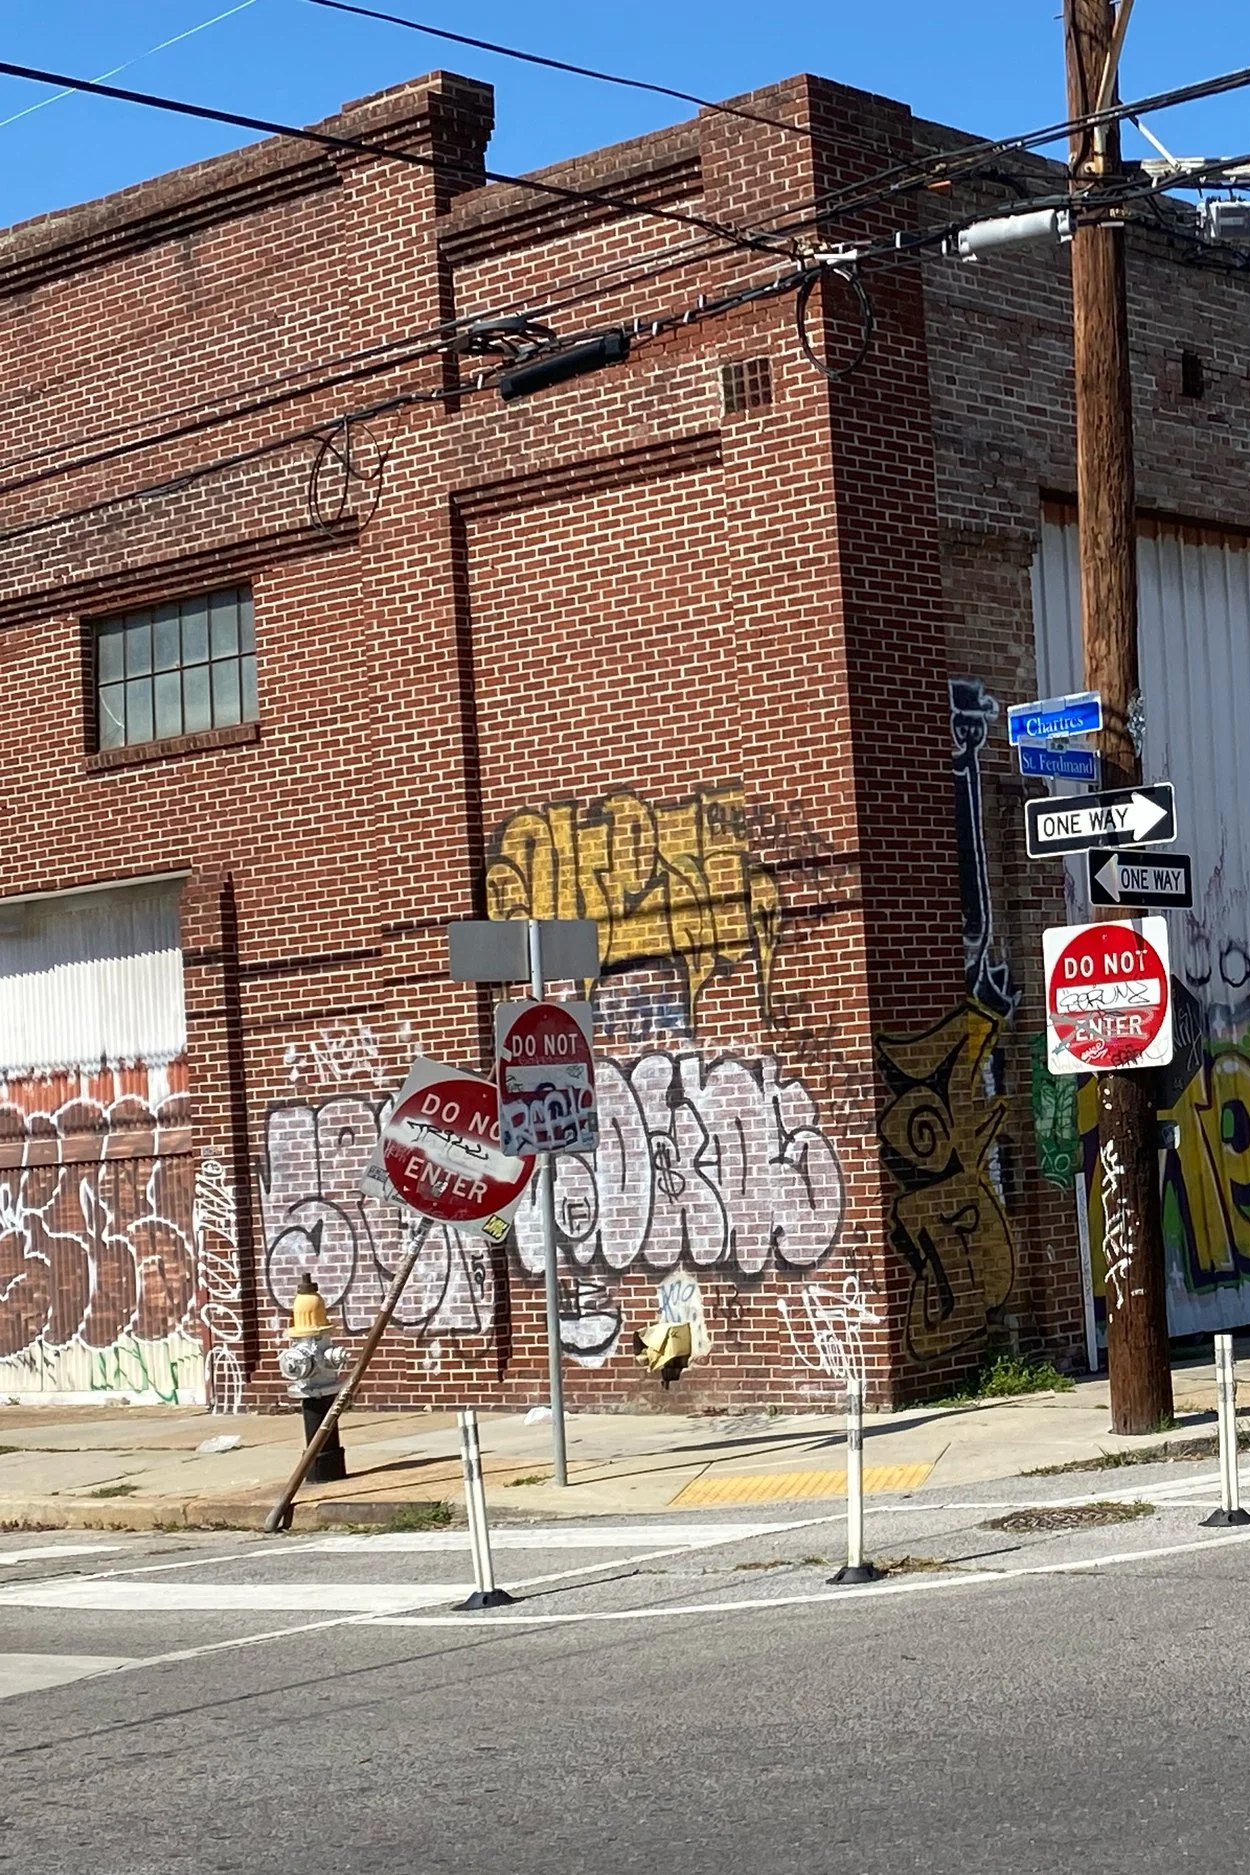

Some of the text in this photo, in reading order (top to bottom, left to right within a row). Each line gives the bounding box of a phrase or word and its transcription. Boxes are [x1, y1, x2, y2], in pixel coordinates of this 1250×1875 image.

[1026, 715, 1084, 737] Chartres
[1039, 753, 1093, 775] Ferdinand
[1043, 807, 1130, 838] ONE WAY
[1120, 868, 1182, 891] ONE WAY
[1063, 949, 1148, 980] DO NOT
[1074, 1014, 1143, 1043] ENTER
[512, 1033, 578, 1057] DO NOT
[420, 1093, 461, 1123] DO
[469, 1111, 501, 1140] NO
[404, 1155, 489, 1204] ENTER
